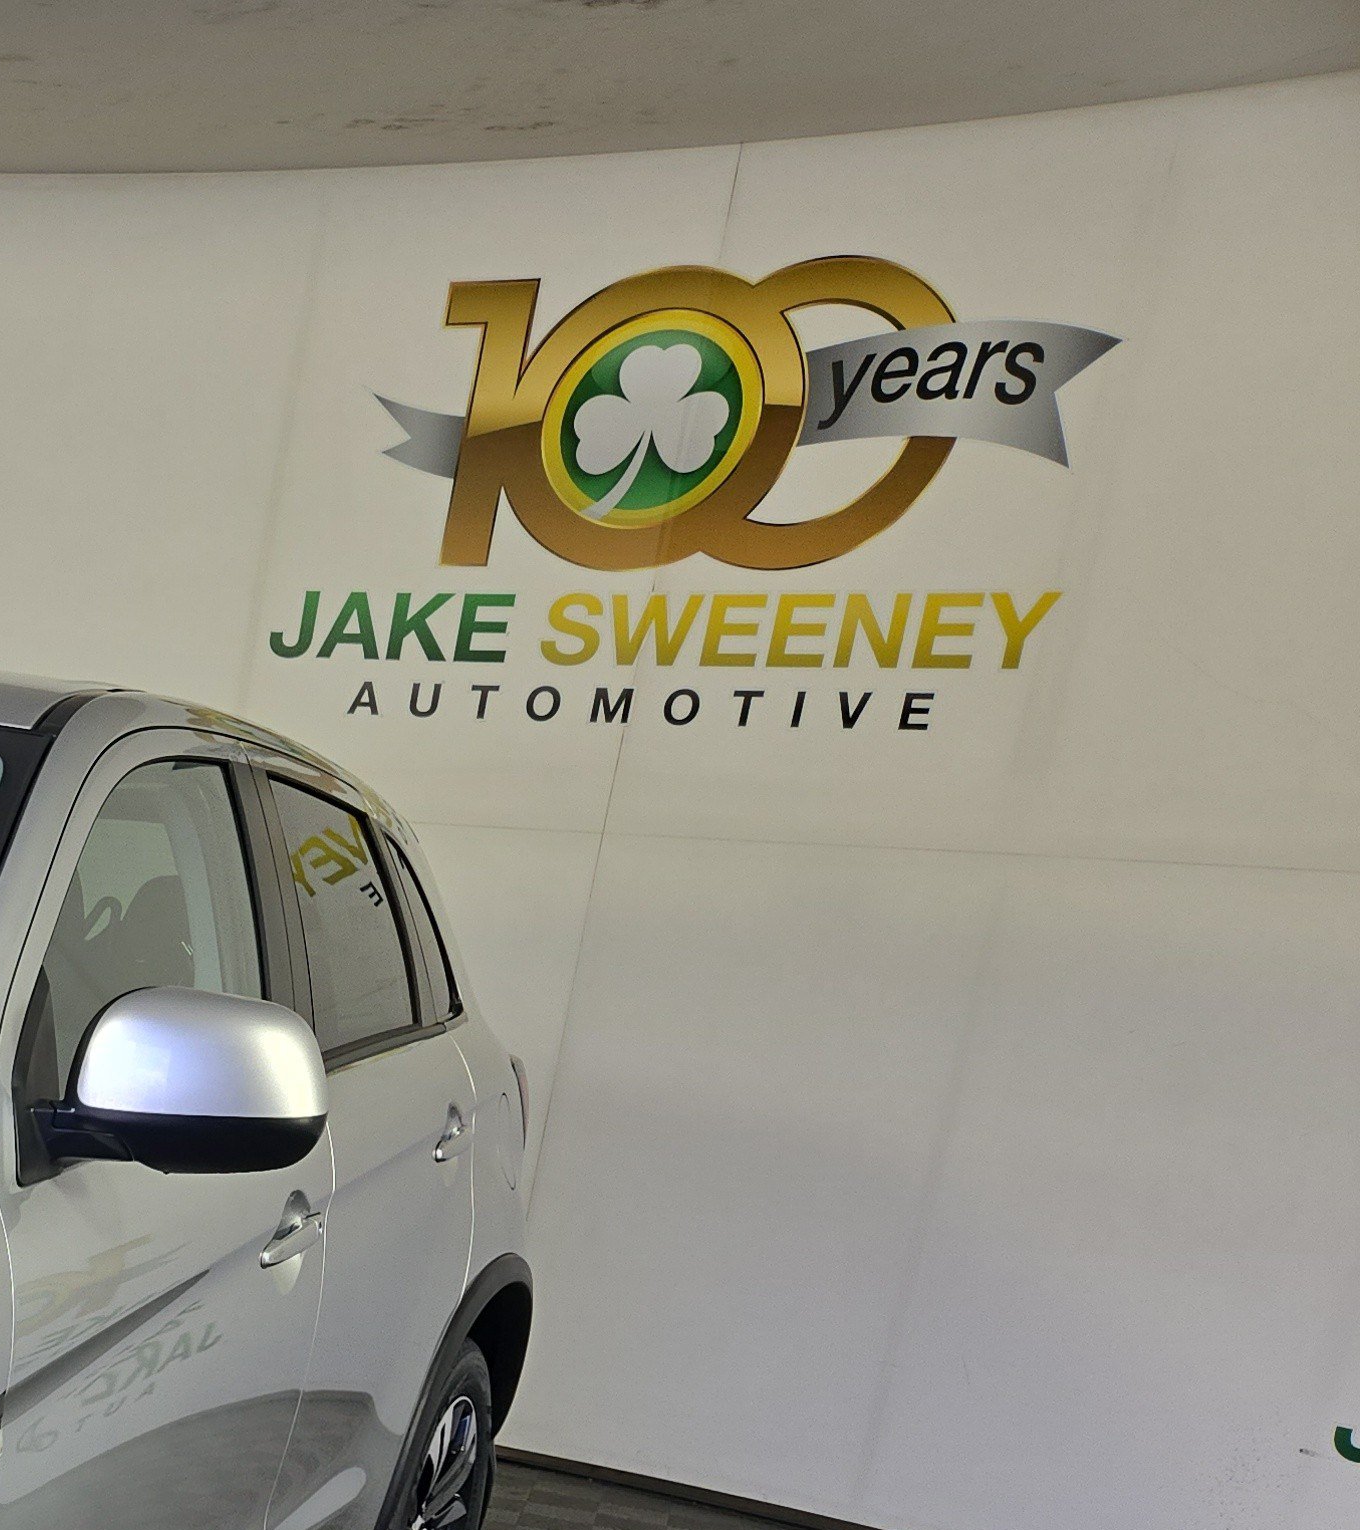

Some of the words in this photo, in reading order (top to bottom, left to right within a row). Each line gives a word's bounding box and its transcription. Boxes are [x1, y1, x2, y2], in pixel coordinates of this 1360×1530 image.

[817, 338, 1046, 431] years
[268, 589, 518, 664] JAKE
[539, 591, 1064, 672] SWEENEY
[346, 681, 937, 732] AUTOMOTIVE
